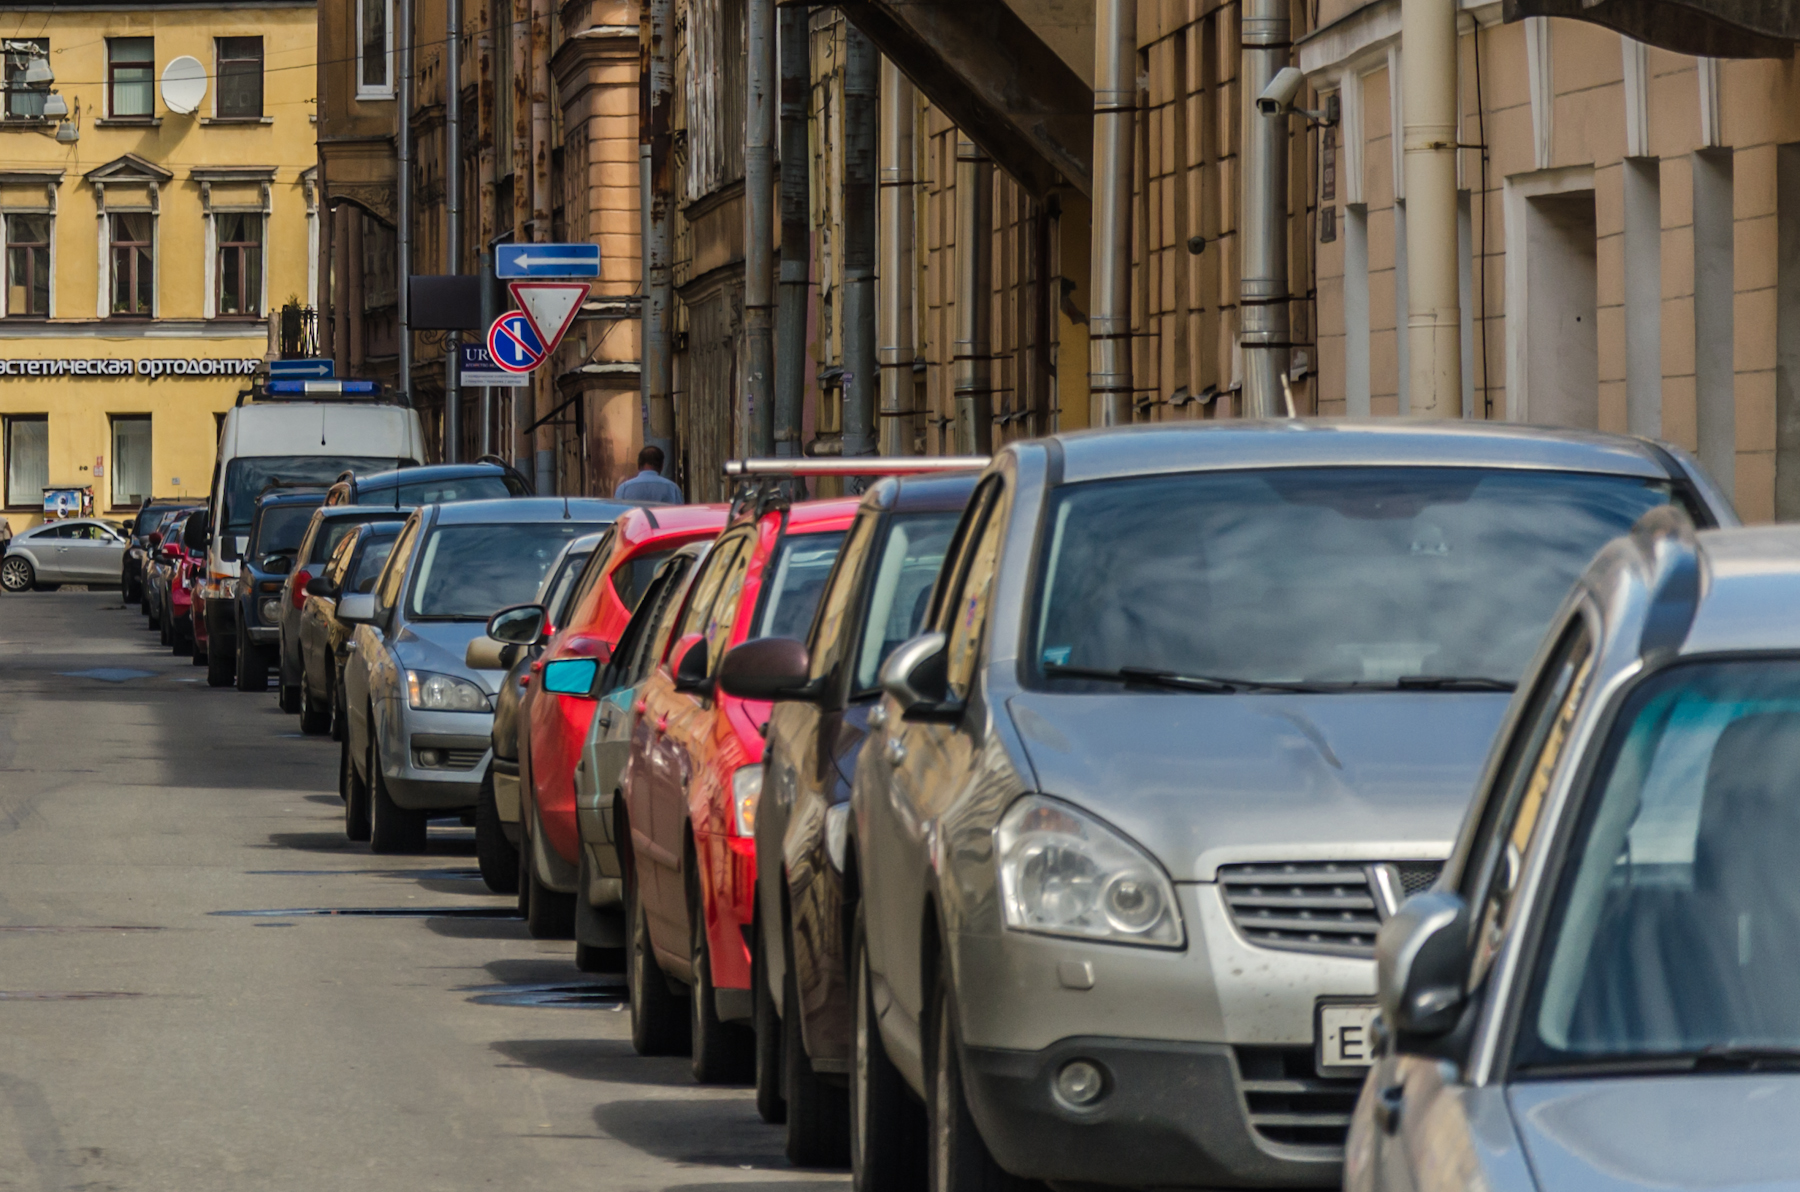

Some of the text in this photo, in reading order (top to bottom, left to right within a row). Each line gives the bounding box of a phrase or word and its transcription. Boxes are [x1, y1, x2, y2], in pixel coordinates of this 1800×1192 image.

[465, 348, 491, 361] UR
[136, 359, 262, 378] ортодонтия
[1339, 1025, 1376, 1060] E
